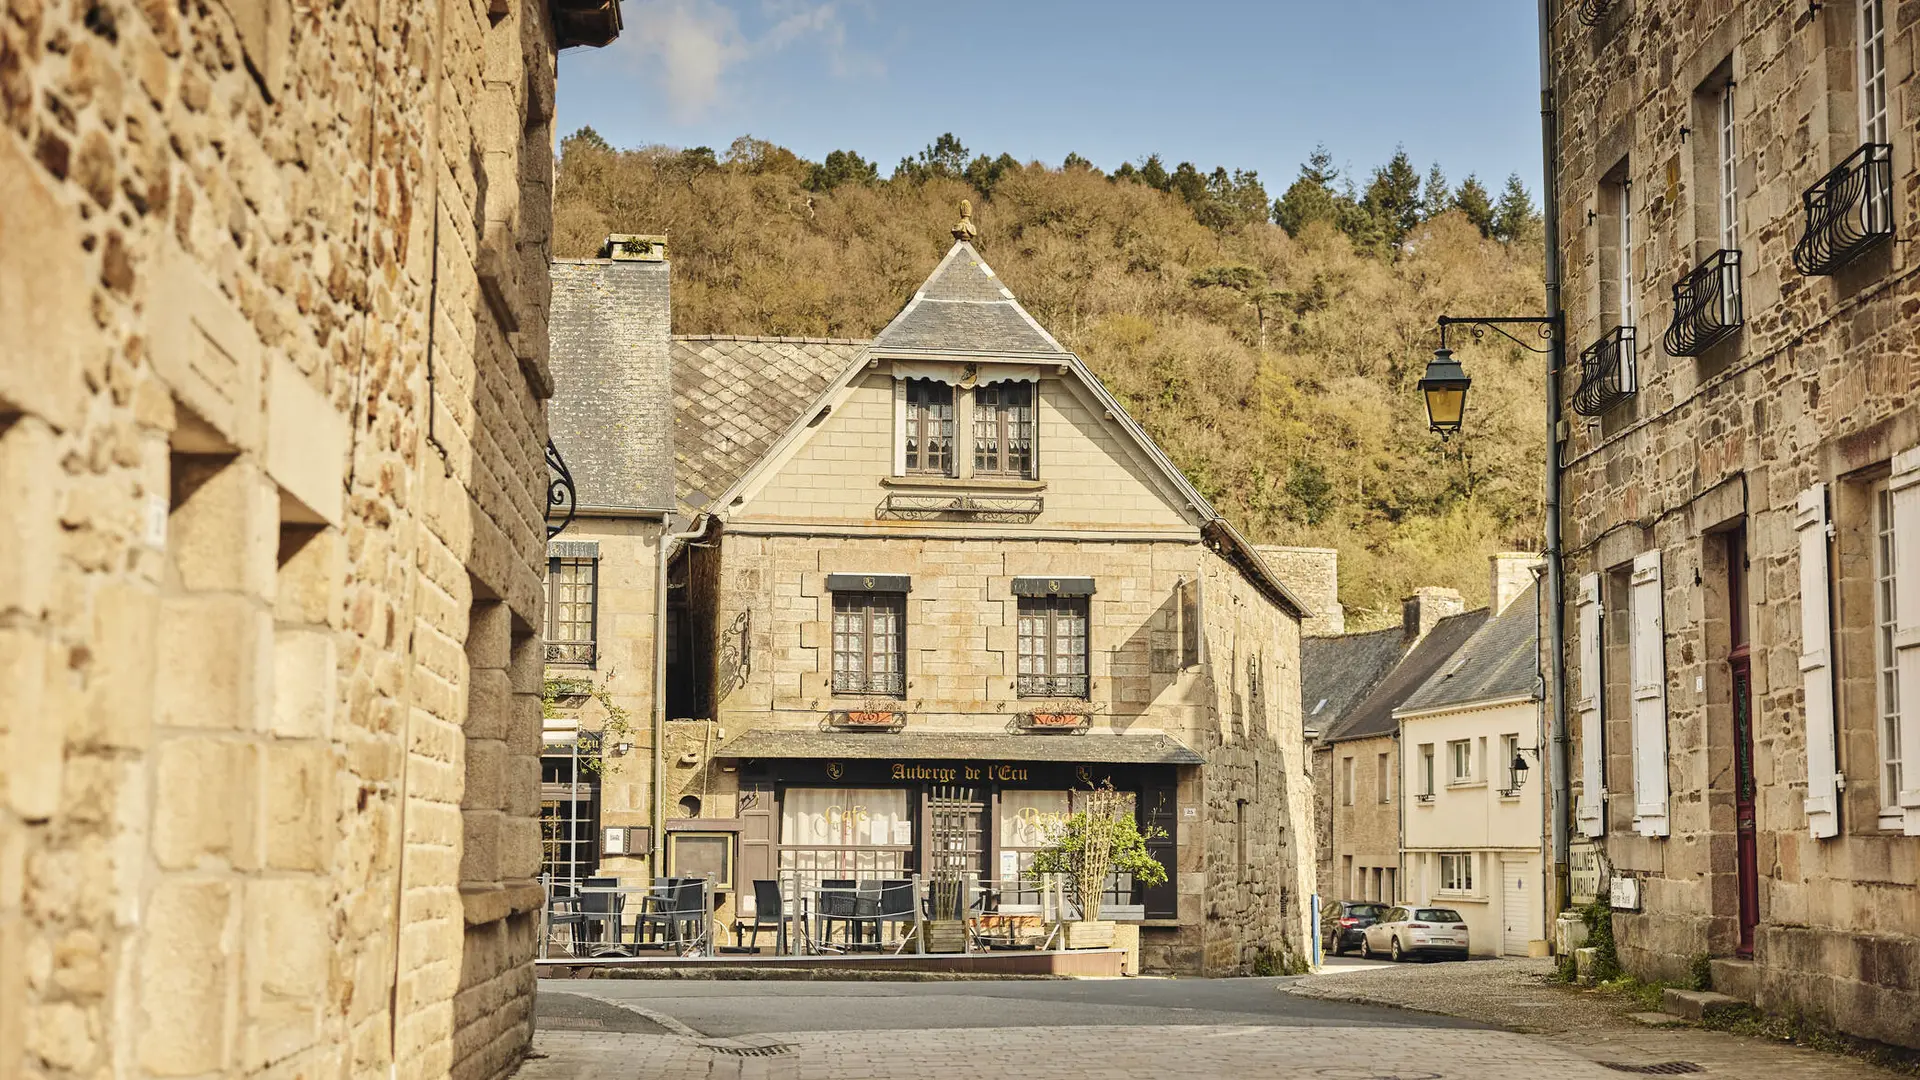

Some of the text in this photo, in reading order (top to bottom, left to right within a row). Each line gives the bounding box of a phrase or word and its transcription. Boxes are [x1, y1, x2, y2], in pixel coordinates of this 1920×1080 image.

[892, 763, 1029, 782] Auberge de l'Ecu
[825, 805, 867, 829] Café
